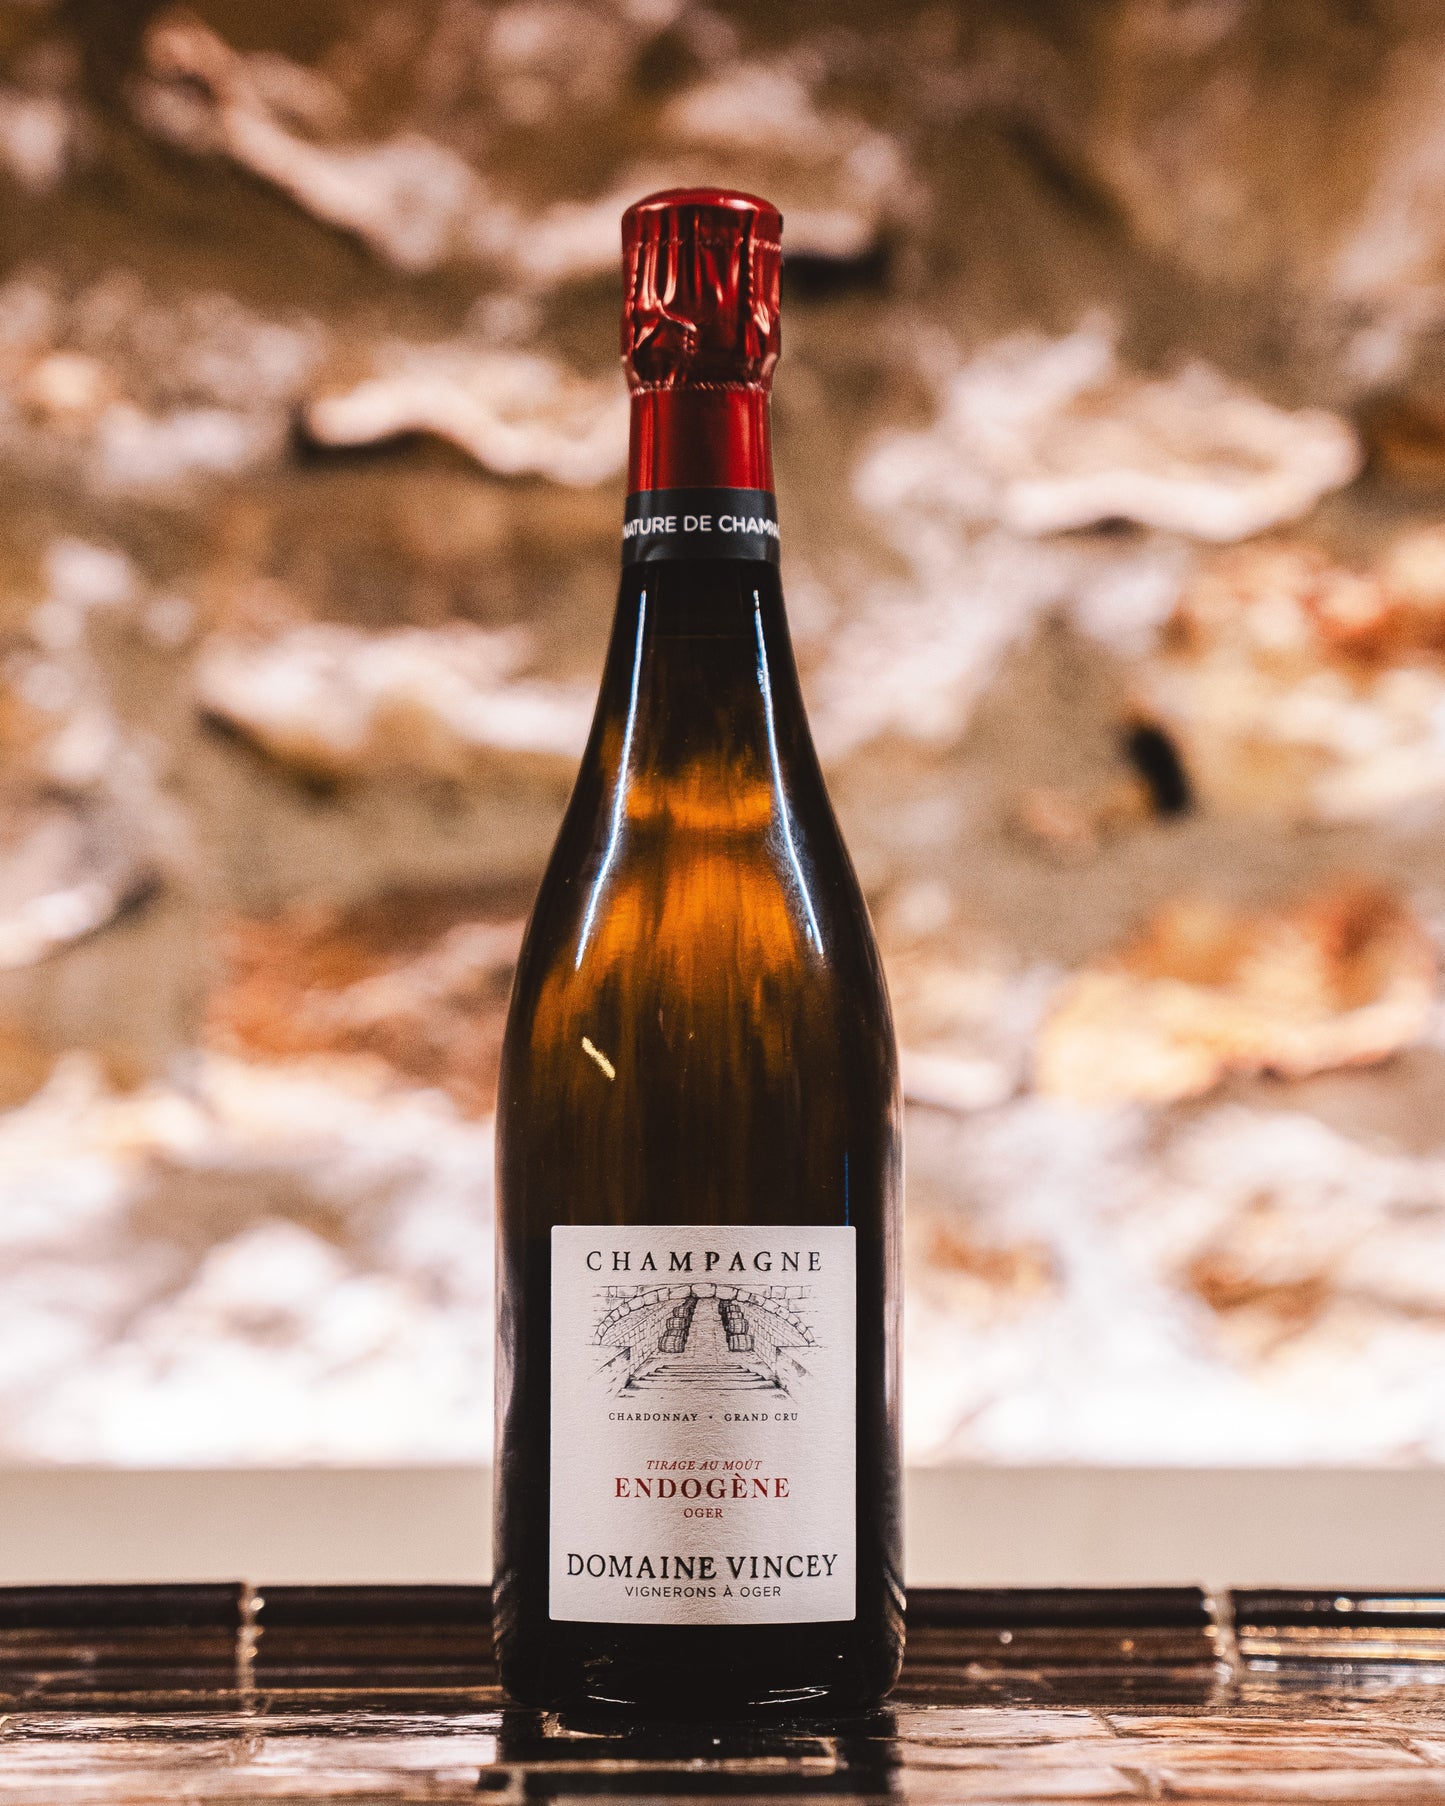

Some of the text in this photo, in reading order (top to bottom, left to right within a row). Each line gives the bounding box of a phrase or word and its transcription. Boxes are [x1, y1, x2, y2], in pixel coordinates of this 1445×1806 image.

[683, 515, 713, 532] DE
[586, 1250, 822, 1272] CHAMPAGNE
[608, 1411, 799, 1422] CHARDONNAY GRAND CRU
[646, 1459, 695, 1471] TIRAGE
[699, 1459, 719, 1471] AU
[614, 1473, 790, 1499] ENDOGÈNE
[683, 1507, 724, 1519] OGER
[567, 1553, 838, 1580] DOMAINE VINCEY
[624, 1584, 782, 1598] VIGNERONS À OGER
